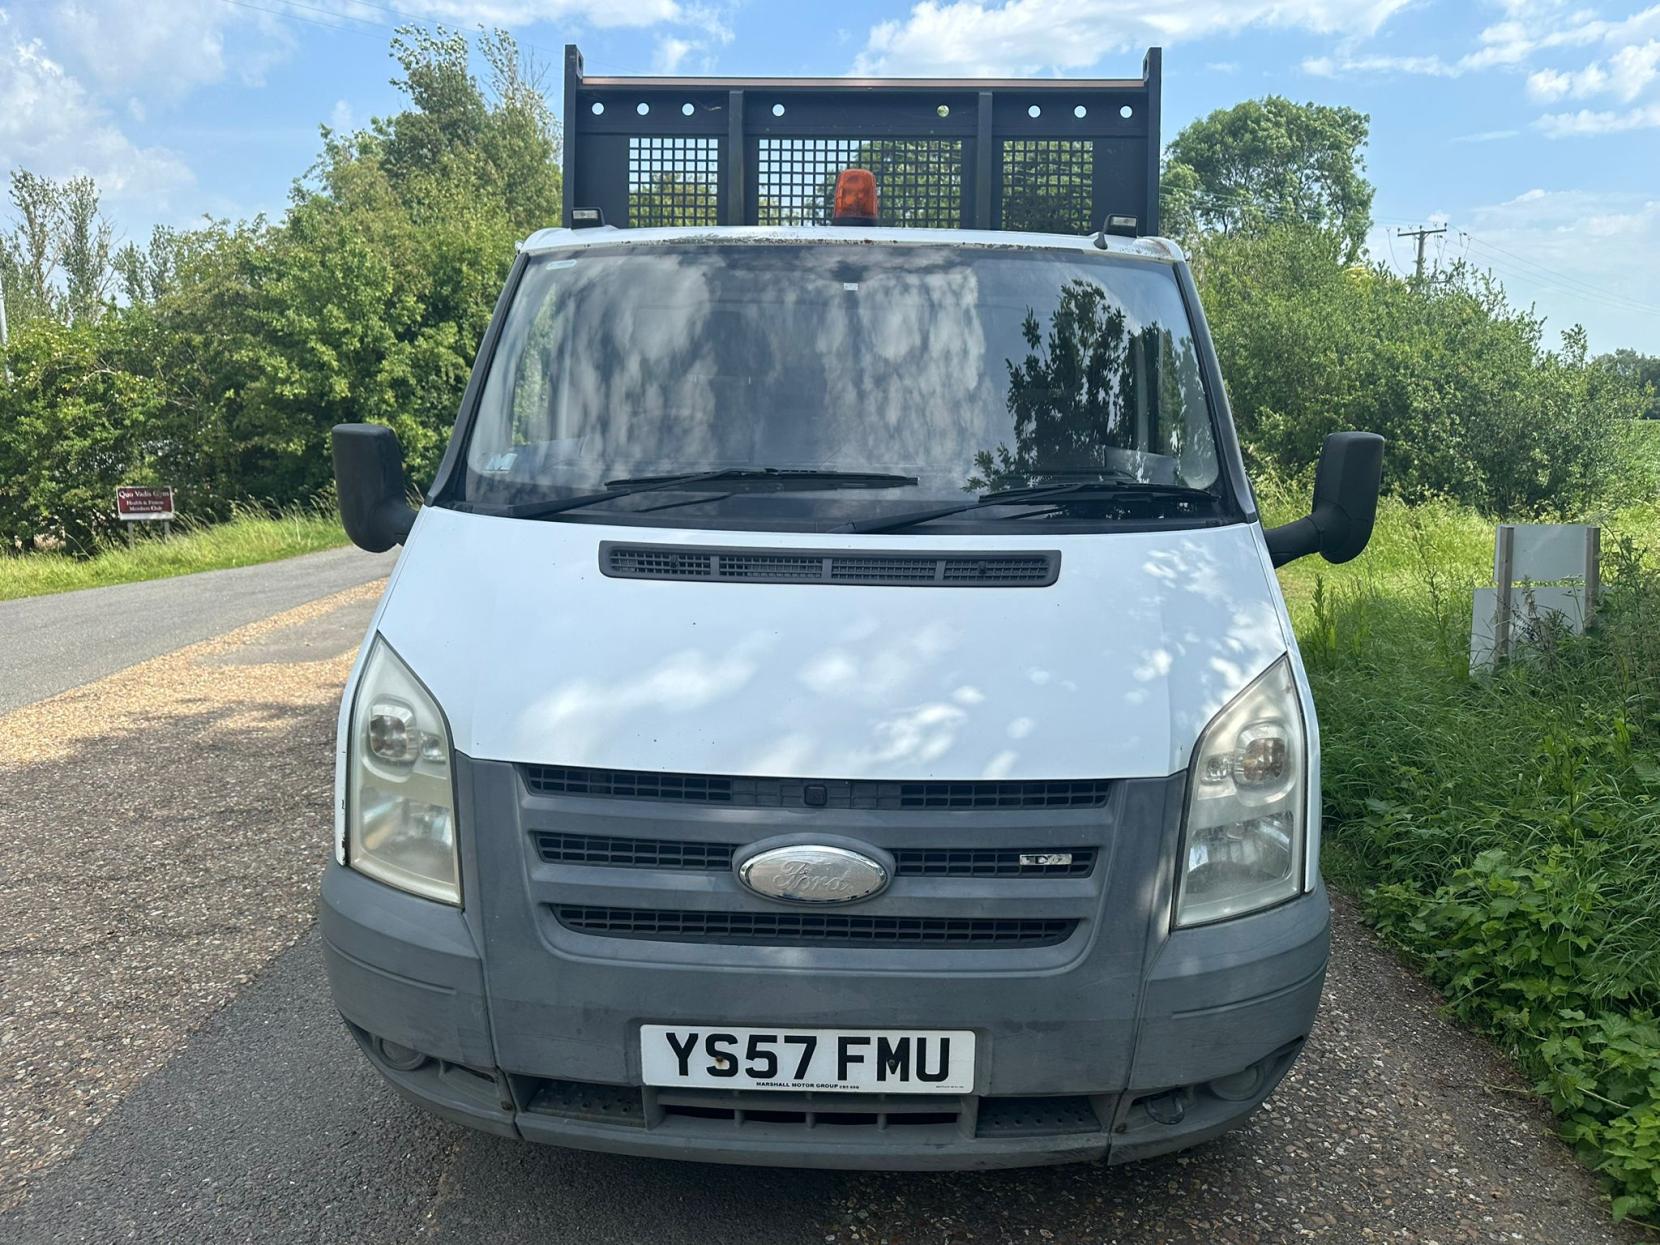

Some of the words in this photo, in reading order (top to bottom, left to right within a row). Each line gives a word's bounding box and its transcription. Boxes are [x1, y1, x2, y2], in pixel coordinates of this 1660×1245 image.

[773, 860, 851, 891] Ford
[665, 1032, 817, 1080] YS57
[837, 1036, 950, 1082] FMU
